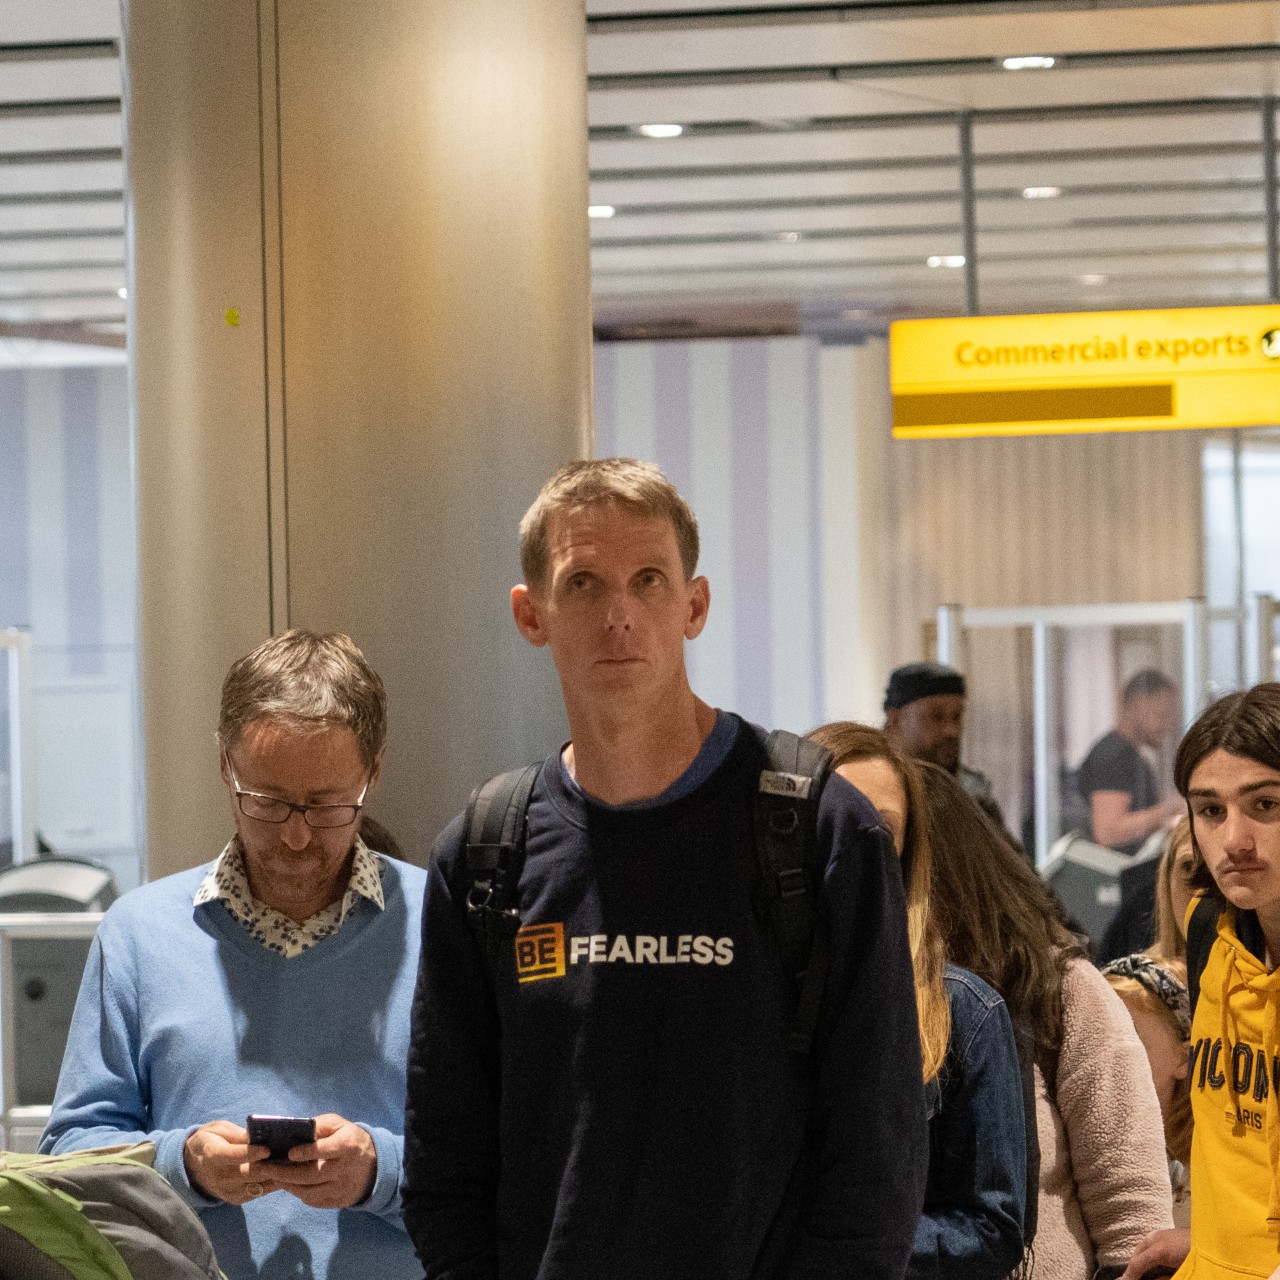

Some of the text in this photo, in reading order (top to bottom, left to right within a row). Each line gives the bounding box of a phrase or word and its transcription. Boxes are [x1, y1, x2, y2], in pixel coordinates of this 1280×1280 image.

[955, 333, 1251, 368] Commercial exports
[517, 935, 734, 969] BE FEARLESS
[1237, 1107, 1262, 1130] ARIS
